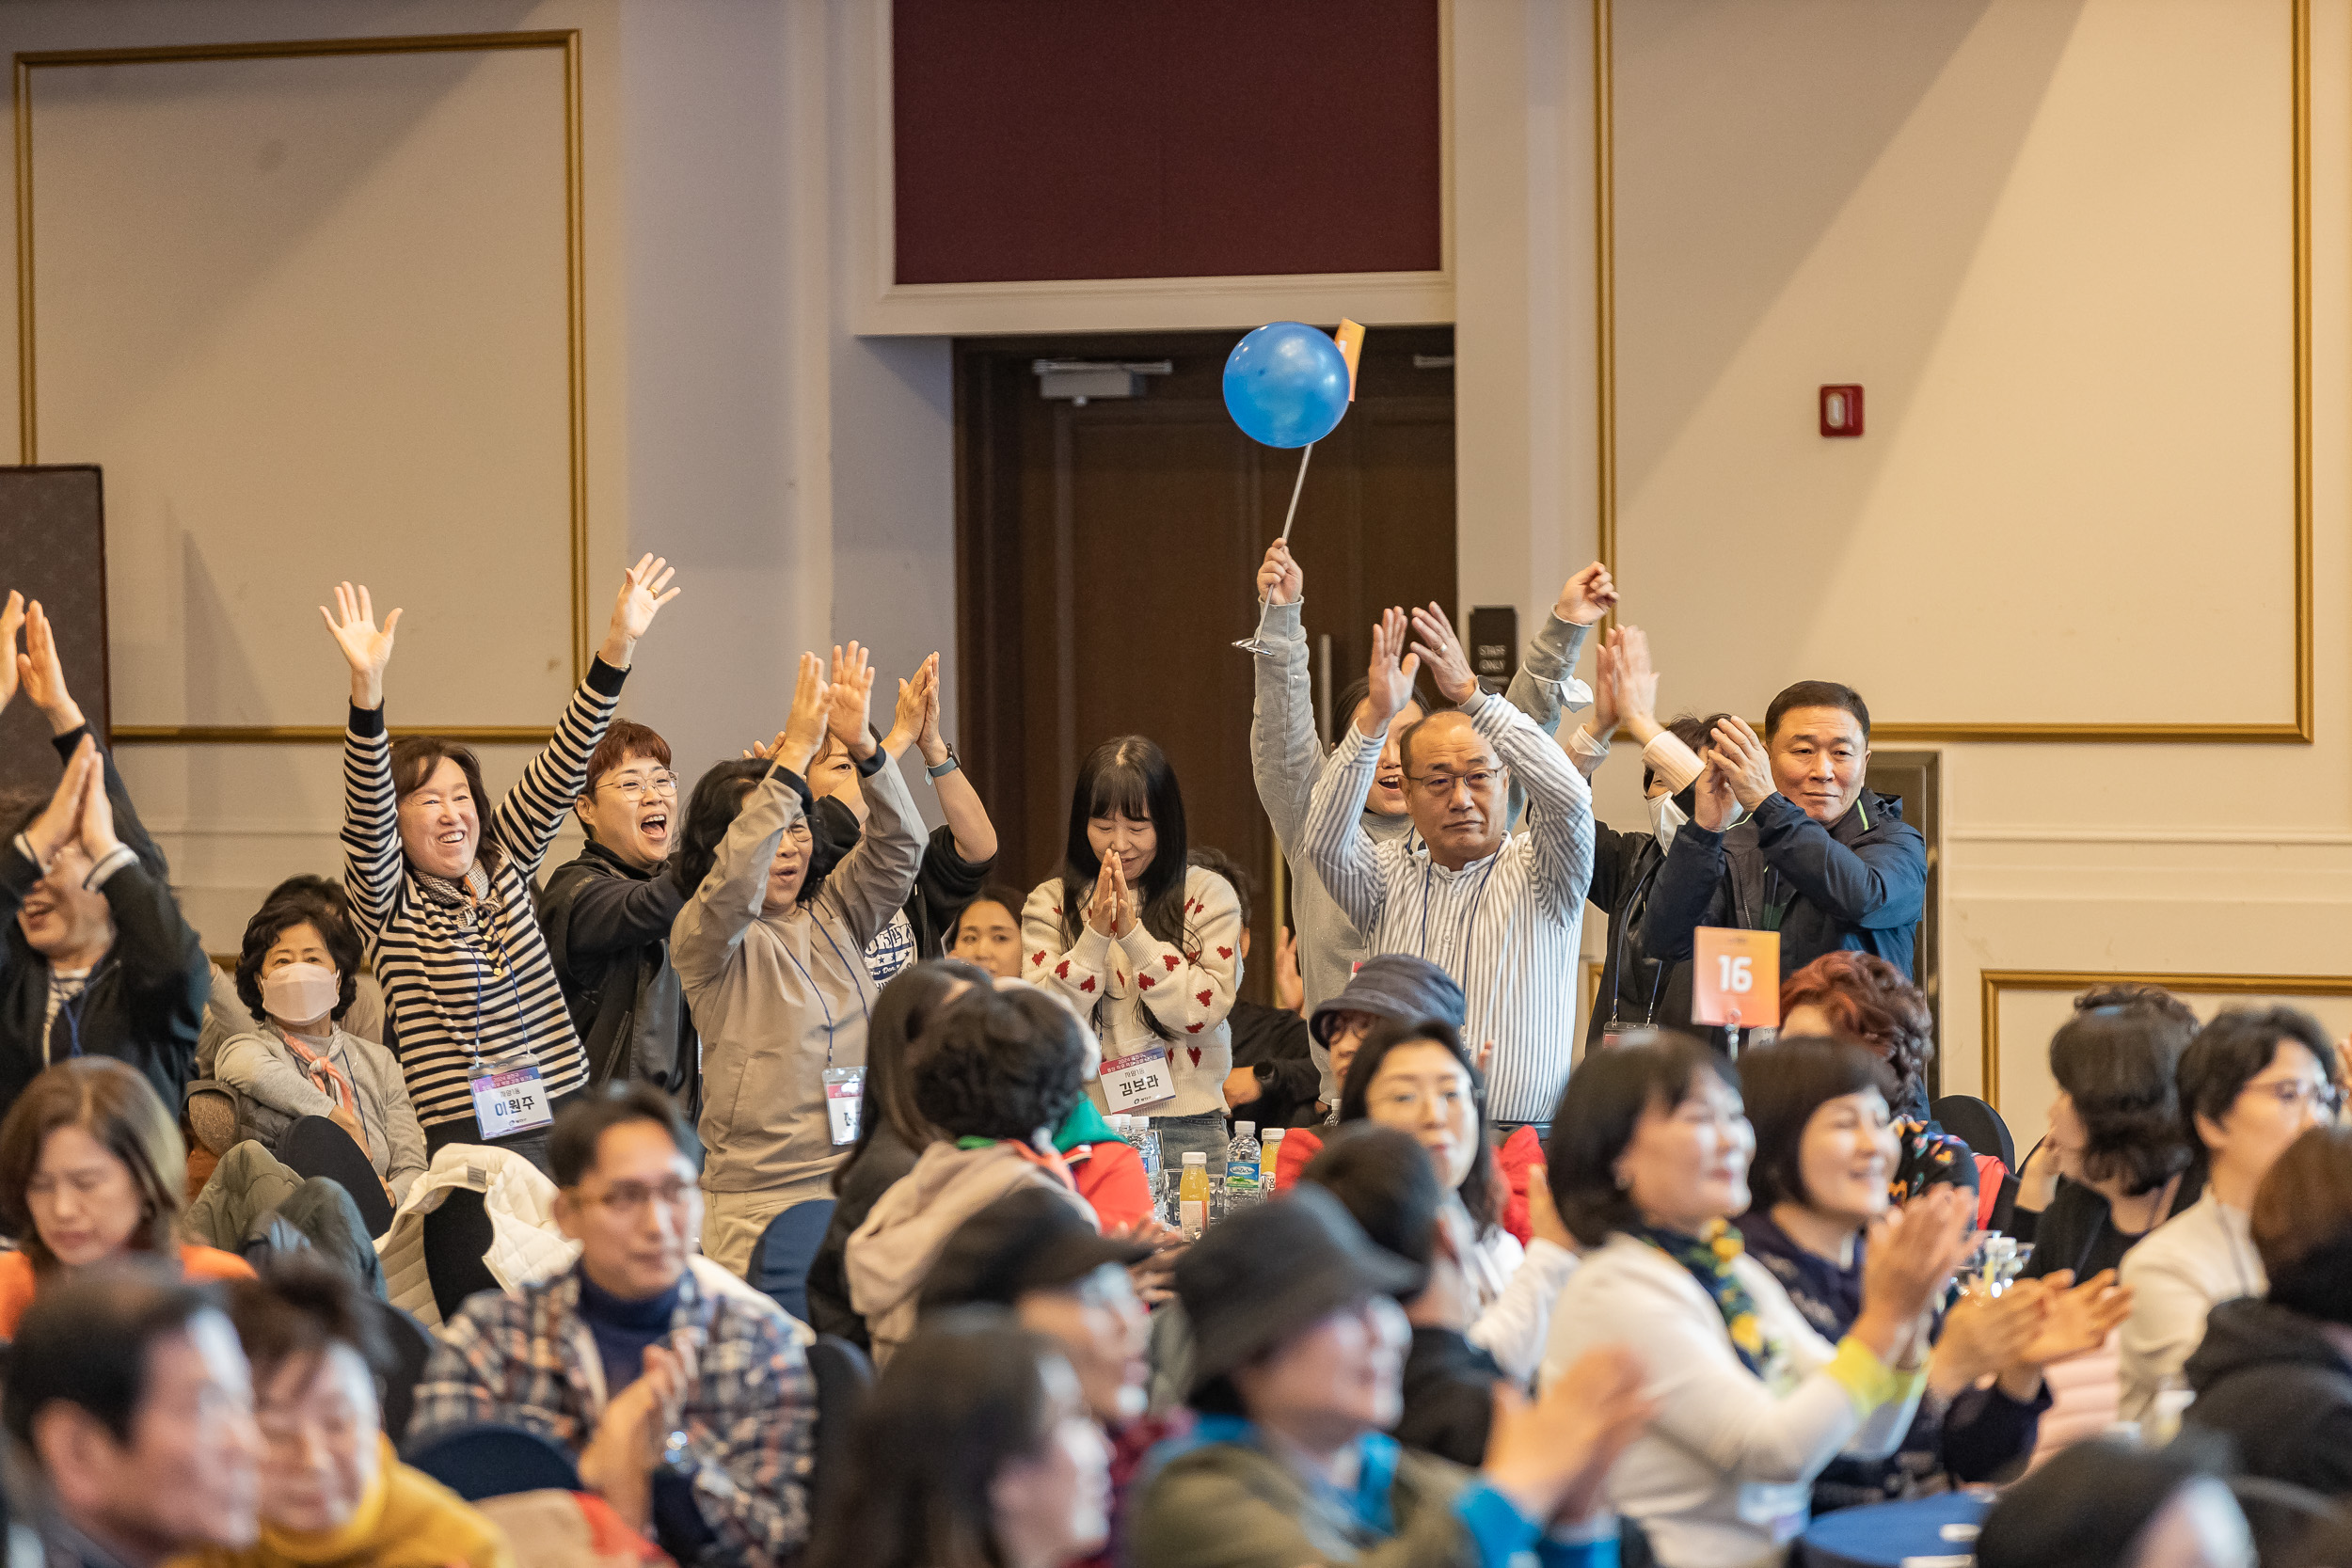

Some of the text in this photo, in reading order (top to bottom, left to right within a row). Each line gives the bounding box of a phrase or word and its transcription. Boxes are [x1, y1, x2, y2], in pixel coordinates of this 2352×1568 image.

[1478, 645, 1506, 657] STAFF
[1478, 659, 1505, 672] ONLY
[1717, 954, 1753, 993] 16
[1120, 1074, 1159, 1097] 김보라
[495, 1096, 534, 1117] 이원주
